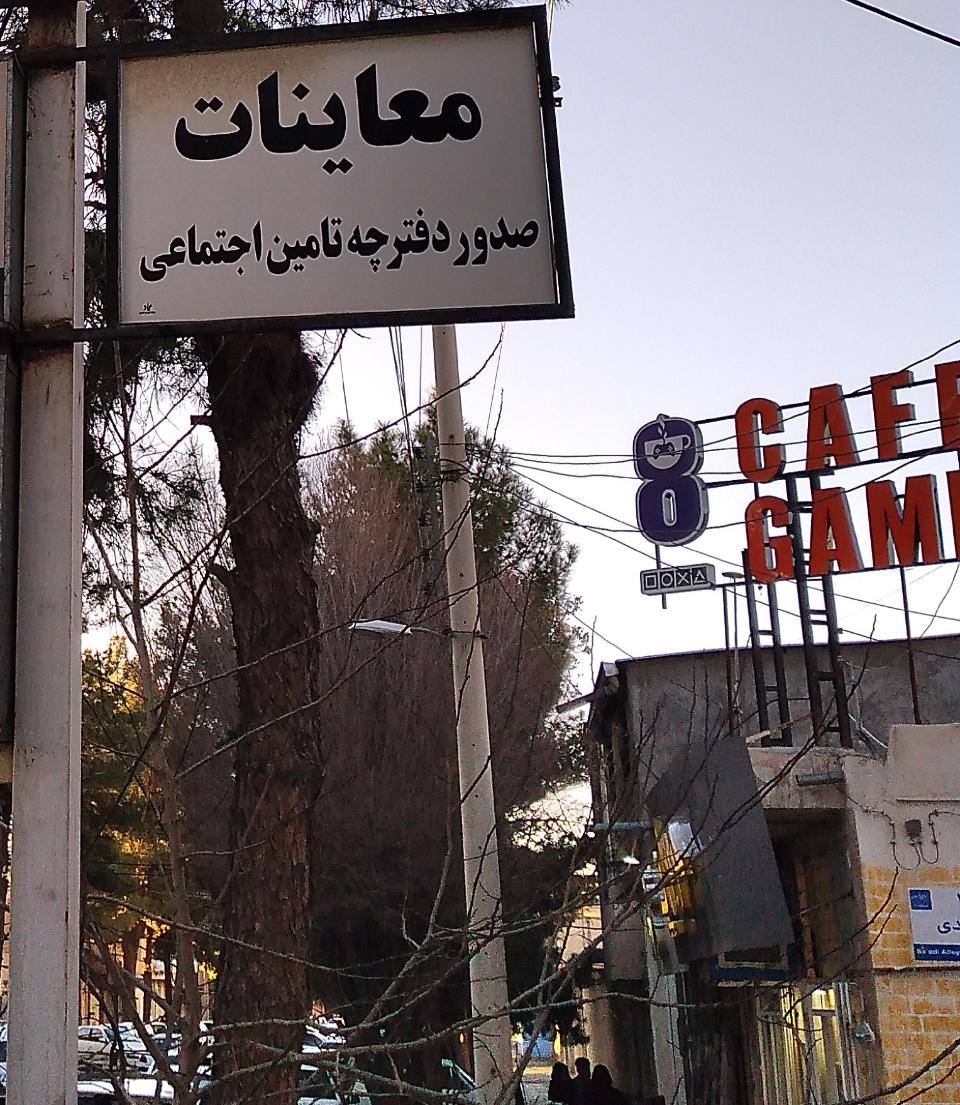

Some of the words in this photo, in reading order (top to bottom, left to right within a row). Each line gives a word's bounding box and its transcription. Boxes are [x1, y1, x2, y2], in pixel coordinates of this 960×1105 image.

[174, 63, 483, 175] معاینات
[139, 220, 262, 284] اجتماعی
[265, 215, 344, 277] تامین
[347, 207, 452, 274] دفترچه
[452, 216, 540, 268] صدور
